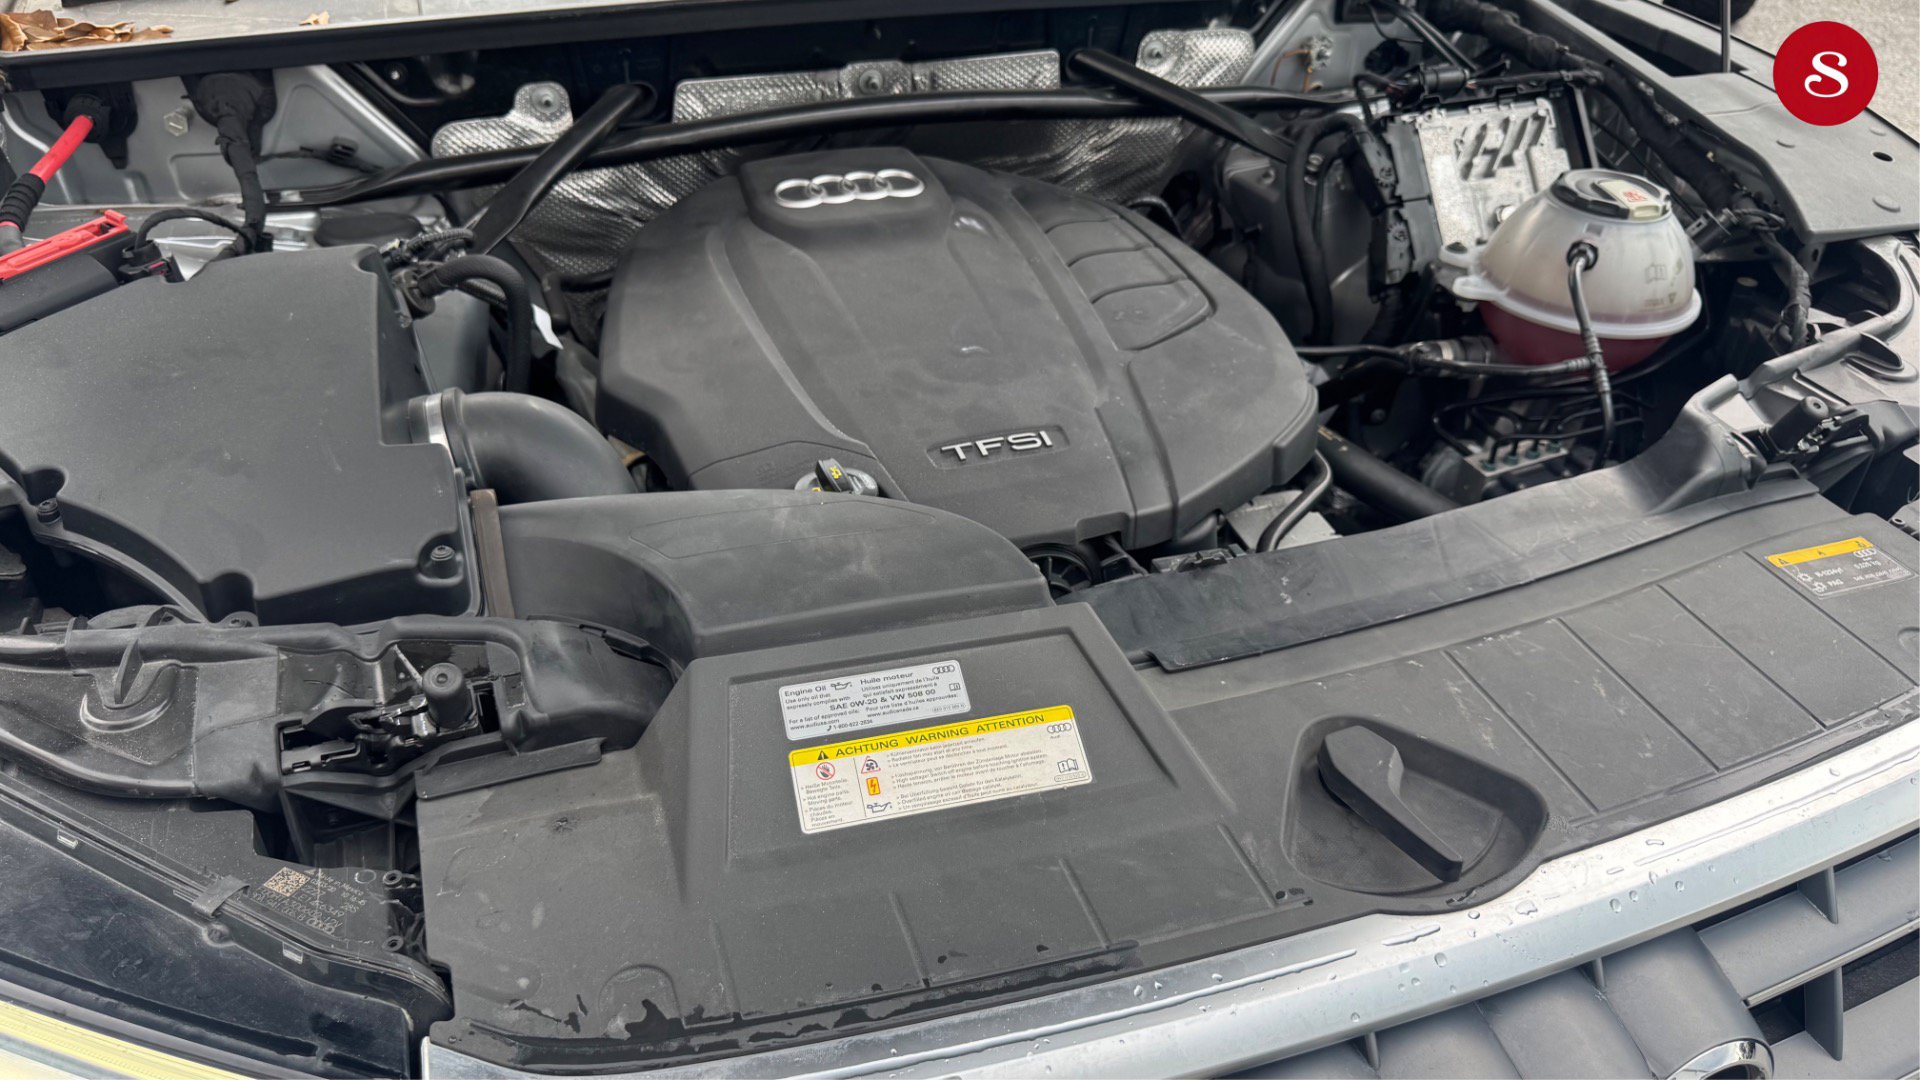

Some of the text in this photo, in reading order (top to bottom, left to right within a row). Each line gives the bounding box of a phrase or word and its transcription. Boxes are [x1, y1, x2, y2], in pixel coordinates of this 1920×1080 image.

[941, 430, 1053, 461] TFSI
[860, 672, 914, 685] Huile moteur
[784, 687, 813, 698] Engine
[829, 703, 848, 711] SAE
[850, 698, 878, 708] 0W-20
[821, 711, 847, 720] approved
[836, 714, 1045, 757] ACHTUNG WARNING ATTENTION
